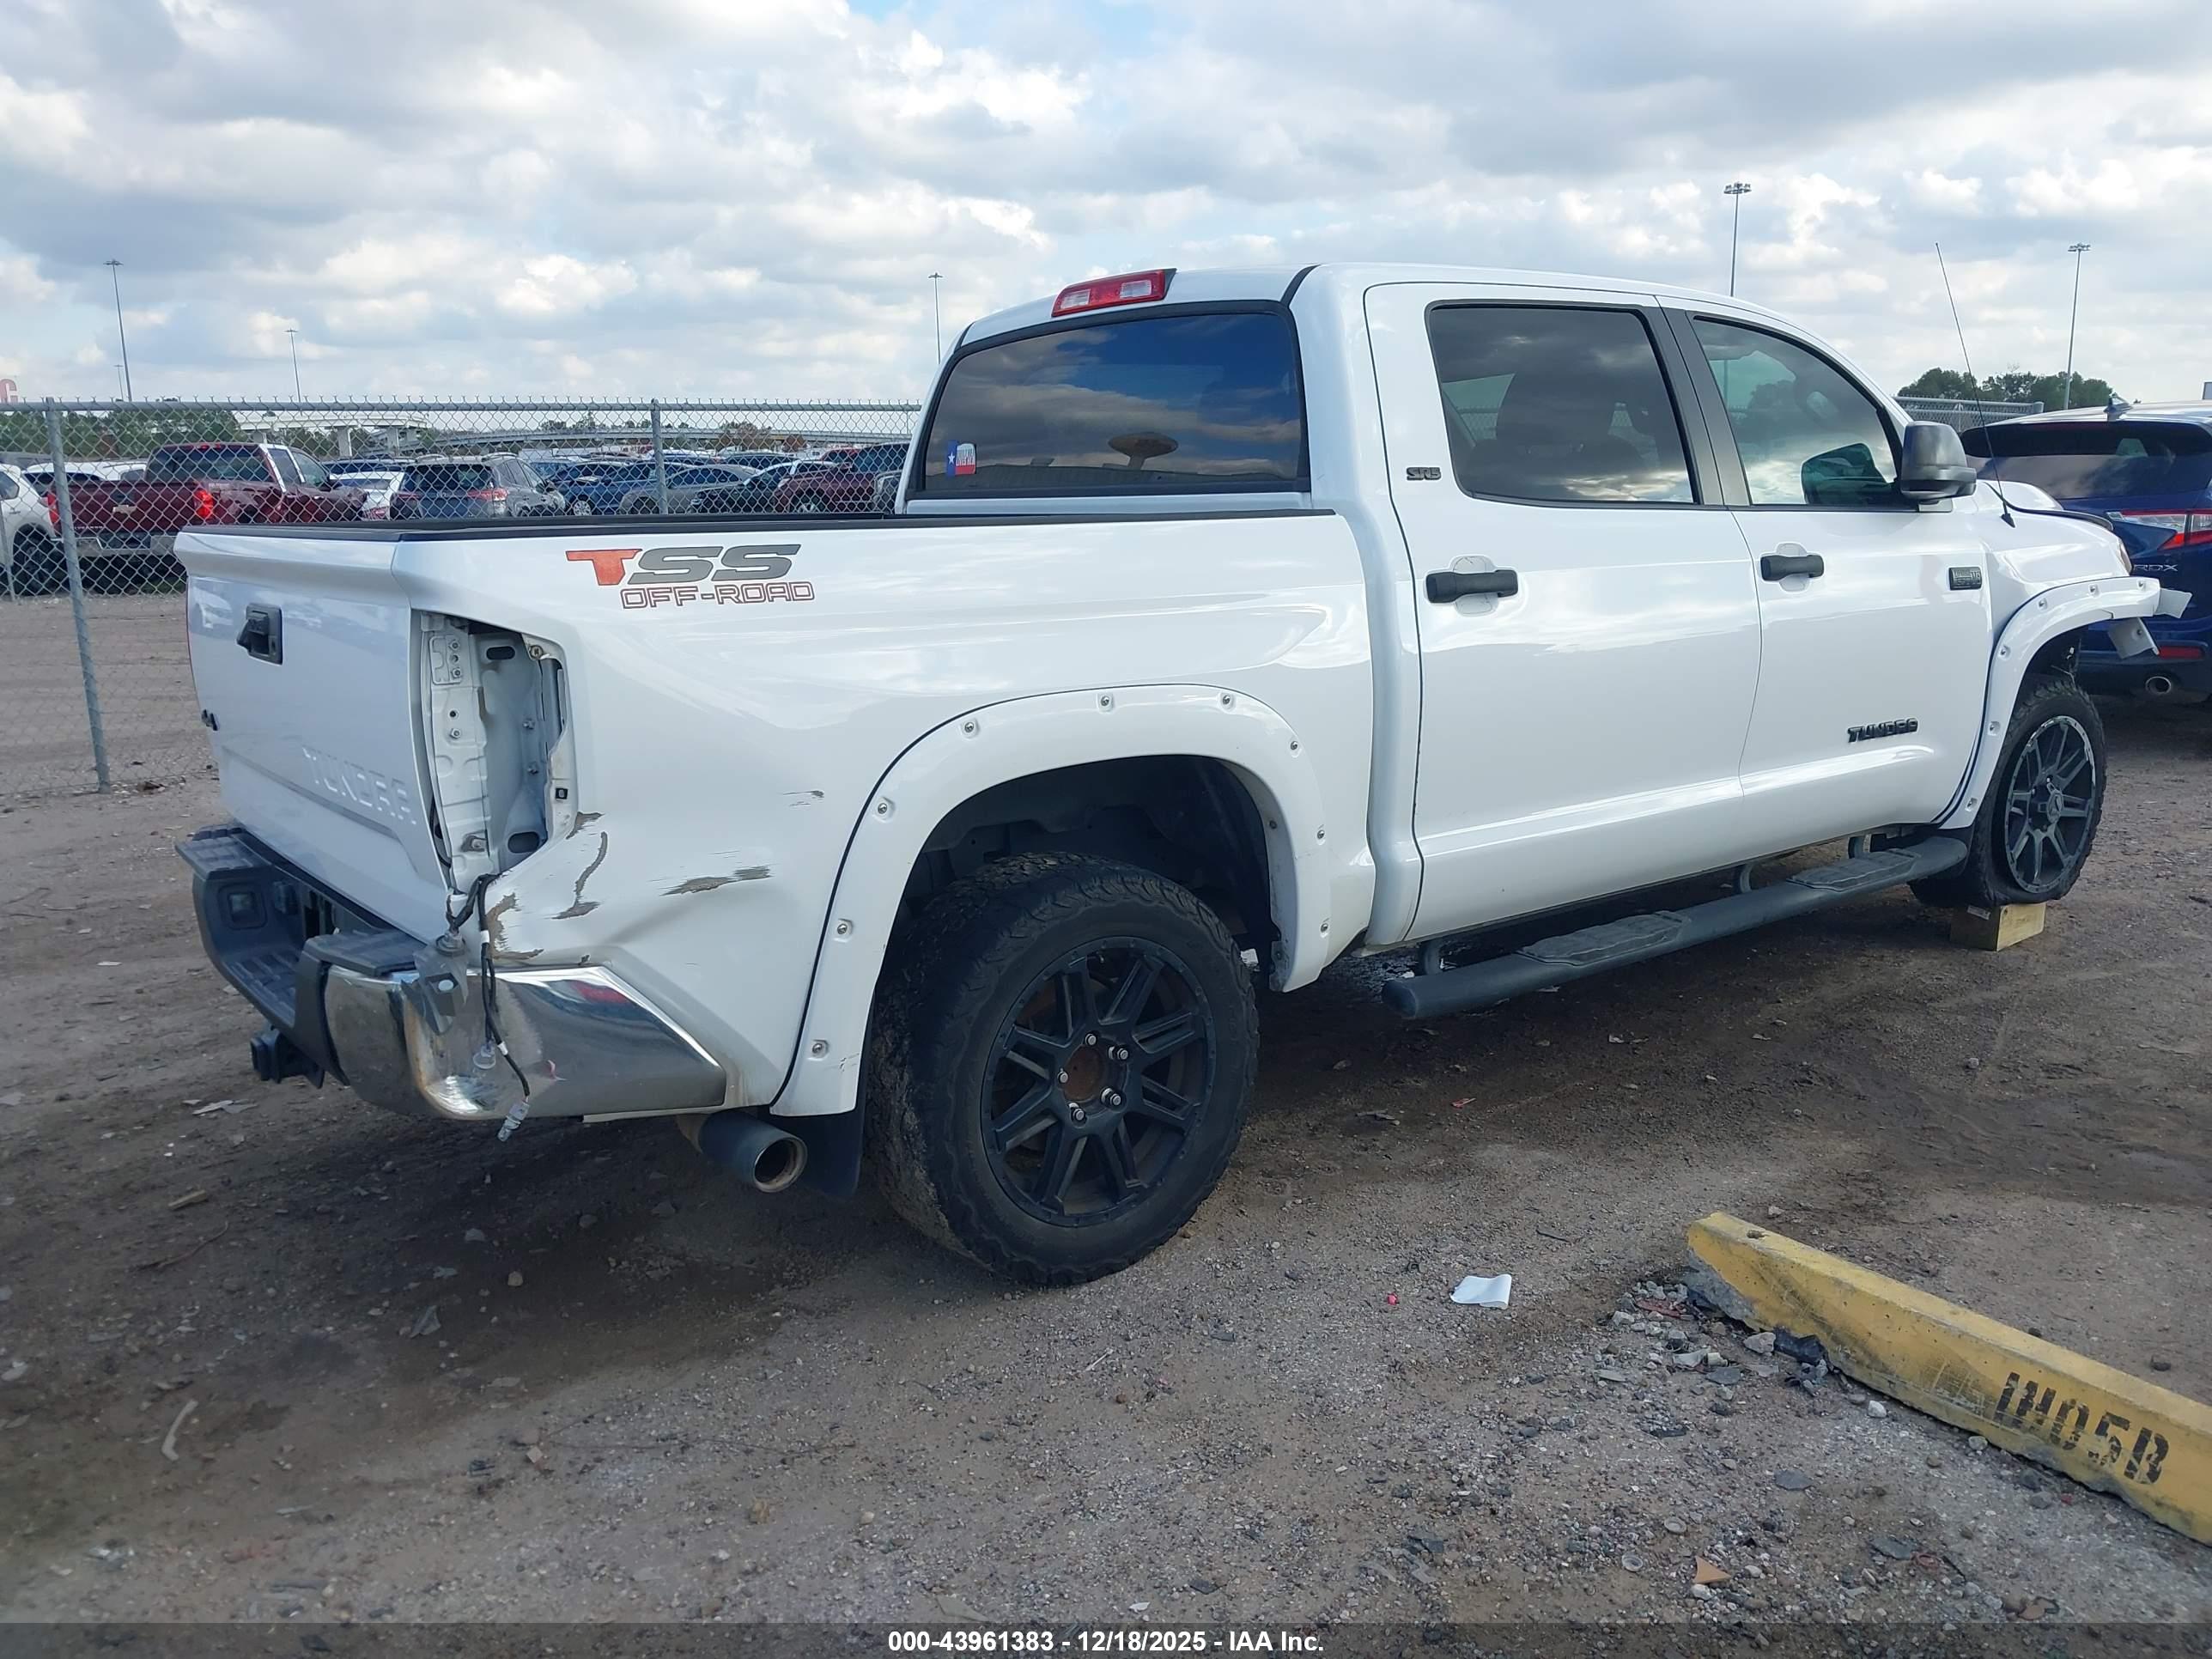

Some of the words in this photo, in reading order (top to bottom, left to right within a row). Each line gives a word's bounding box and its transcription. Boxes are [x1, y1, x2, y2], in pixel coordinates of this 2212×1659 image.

[1406, 466, 1442, 481] SR5
[565, 544, 802, 586] TSS
[619, 580, 816, 610] OFF-ROAD
